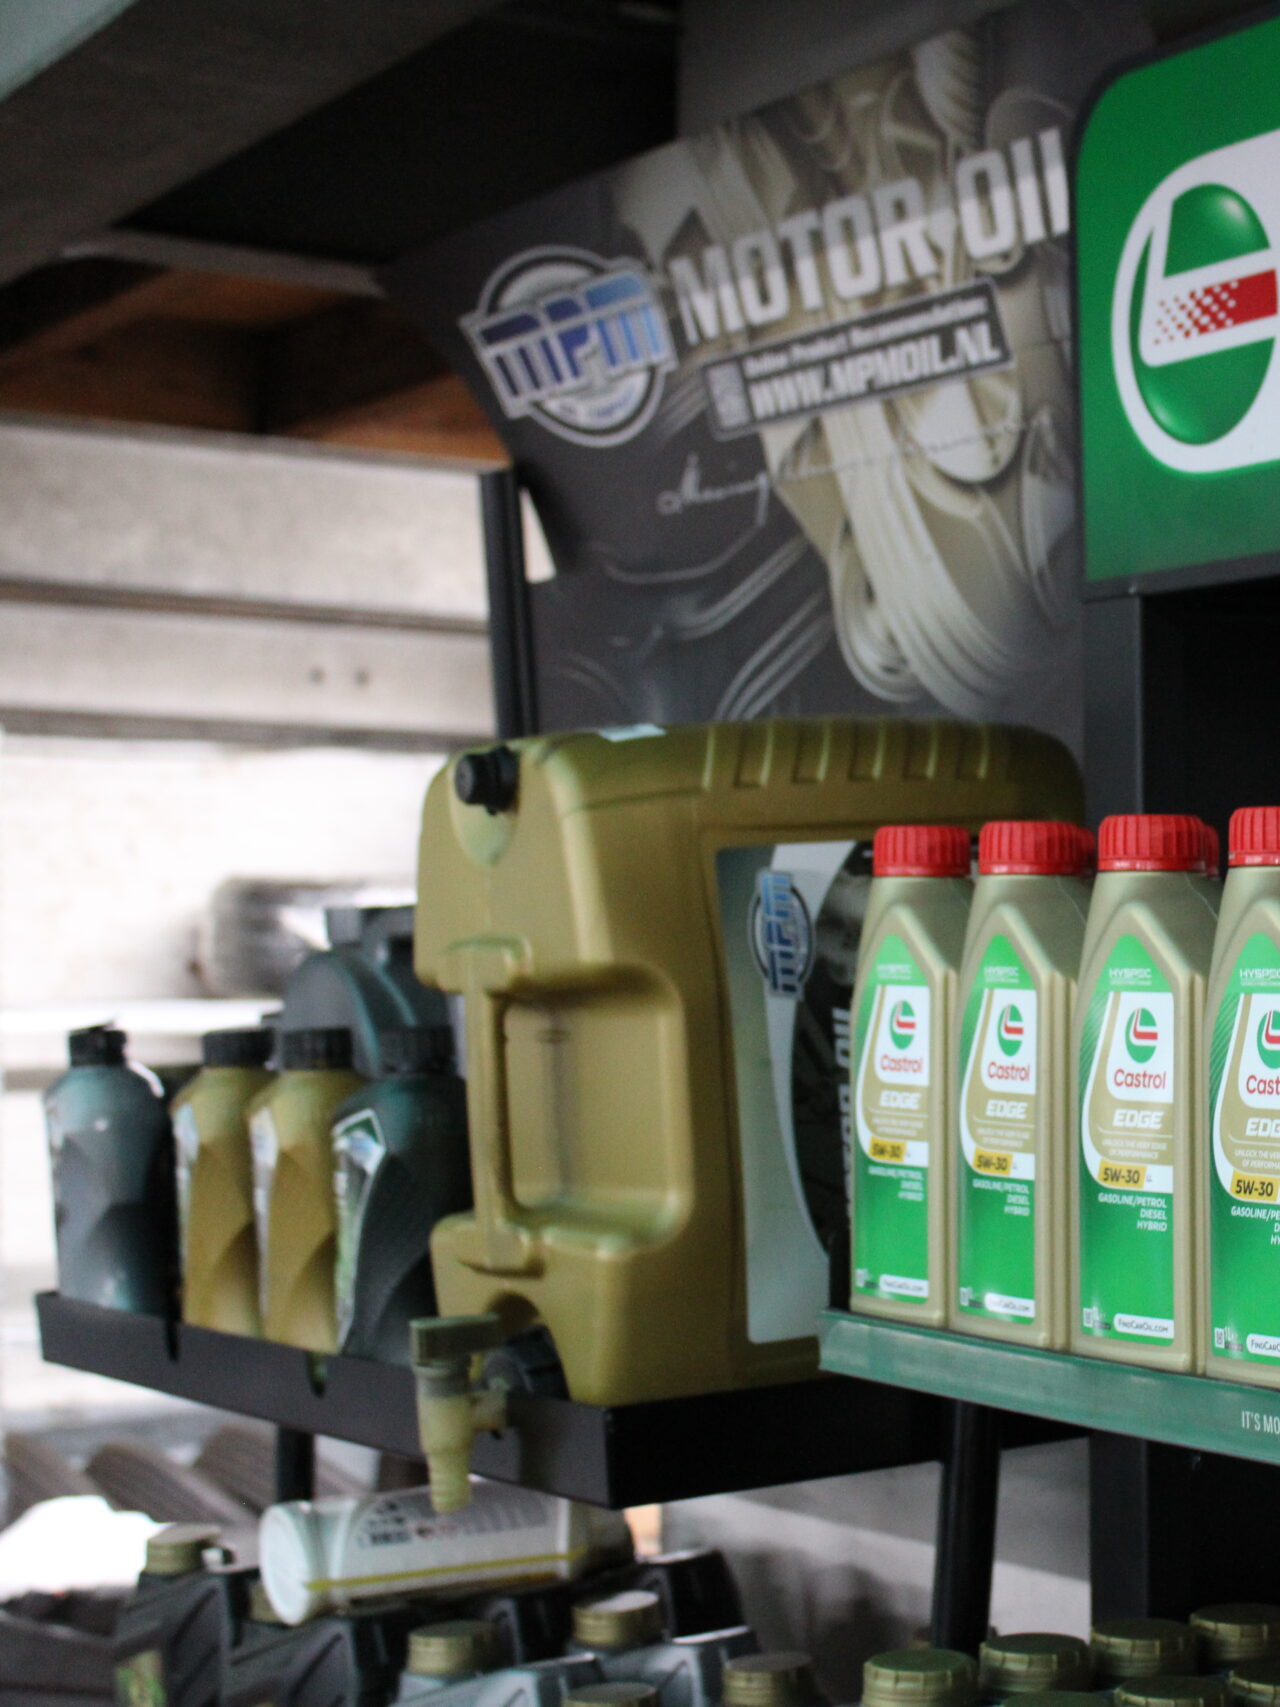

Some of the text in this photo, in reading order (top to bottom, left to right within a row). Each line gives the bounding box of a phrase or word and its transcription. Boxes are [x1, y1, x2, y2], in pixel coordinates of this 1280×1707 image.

[668, 178, 939, 345] MOTOR
[880, 1054, 923, 1074] Castrol
[987, 1062, 1030, 1081] Castrol
[1113, 1068, 1167, 1089] Castrol
[985, 1099, 1029, 1119] EDGE
[1112, 1108, 1164, 1129] EDGE
[975, 1155, 1008, 1171] 5W-30
[1103, 1167, 1141, 1184] 5W-30
[1235, 1179, 1274, 1197] 5W-30
[1098, 1192, 1167, 1208] GASOLINE/PETROL
[1139, 1208, 1167, 1220] DIESEL
[1136, 1220, 1168, 1232] HYBRID
[1241, 1410, 1261, 1431] IT'S
